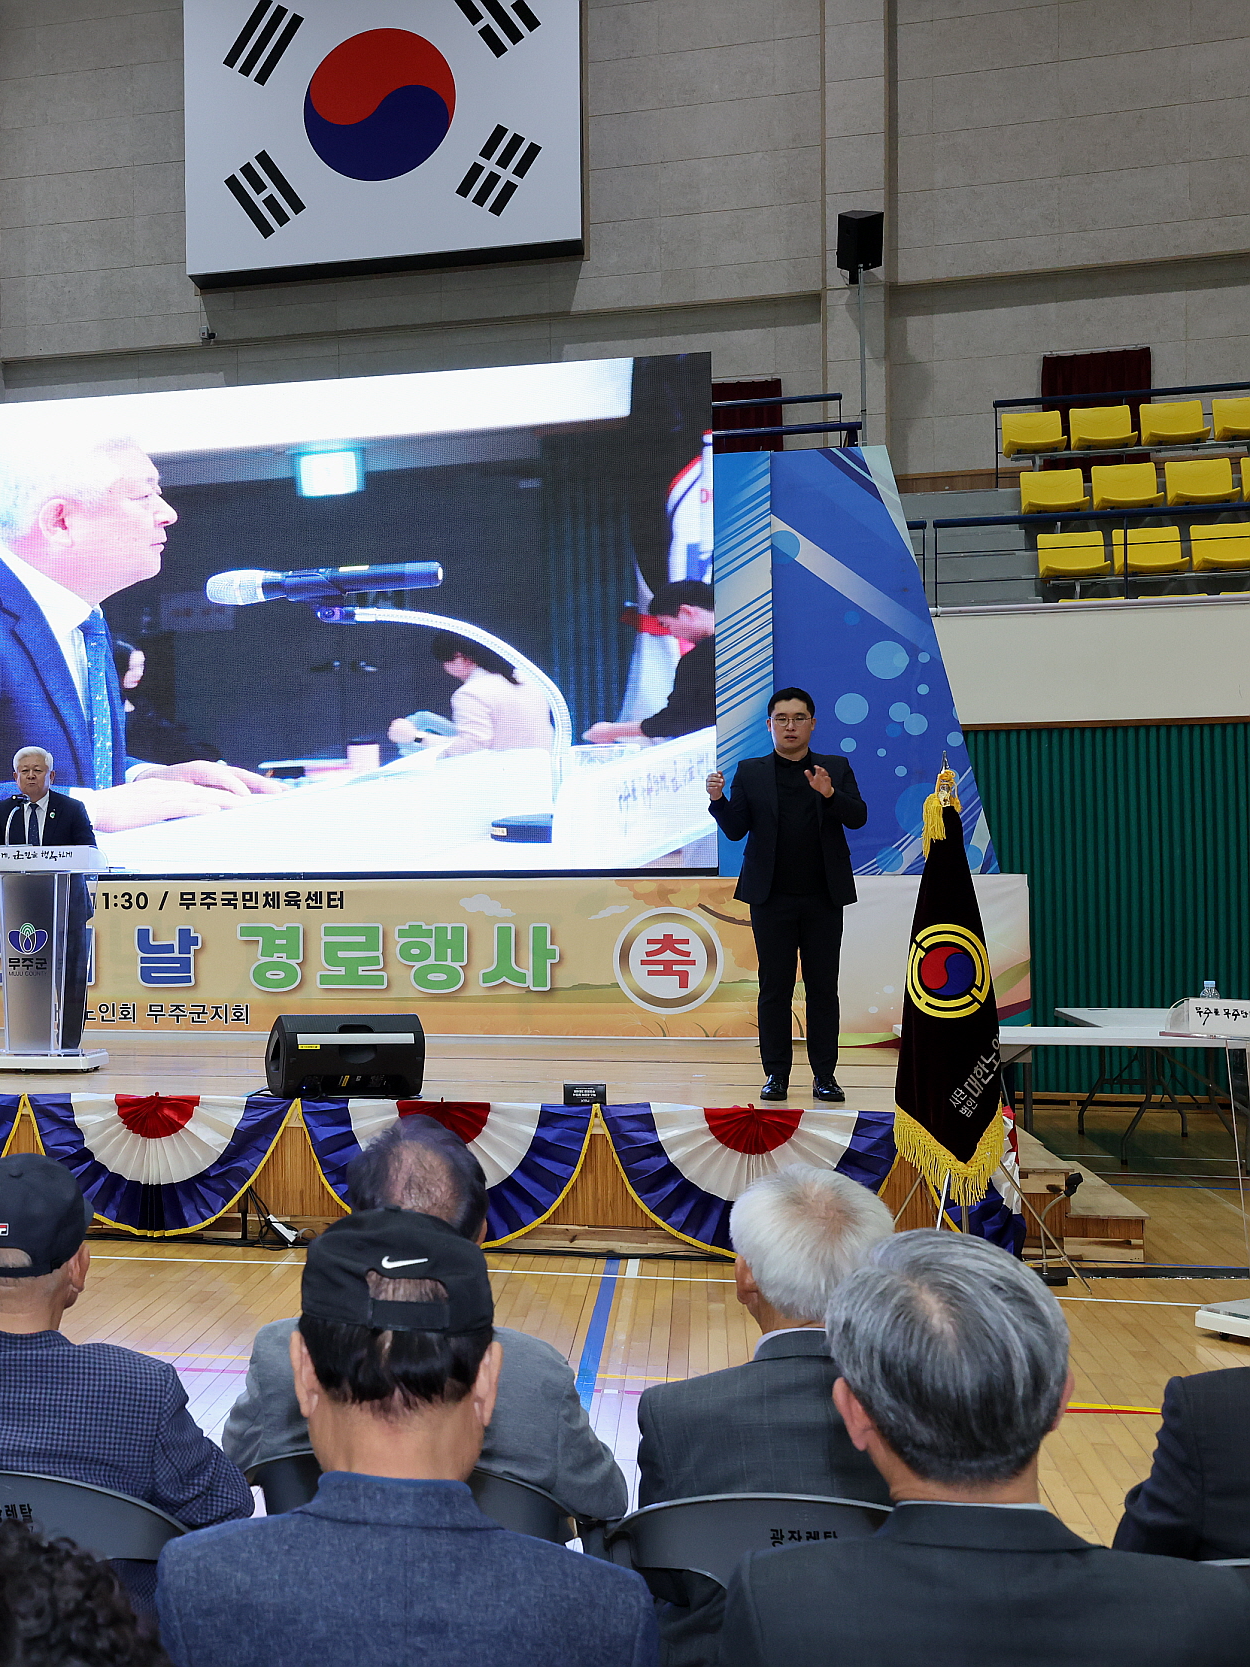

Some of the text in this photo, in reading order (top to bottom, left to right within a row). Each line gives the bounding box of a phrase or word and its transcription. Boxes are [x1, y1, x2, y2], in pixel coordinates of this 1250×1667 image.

[158, 890, 169, 911] /
[178, 889, 345, 911] 무주국민체육센터
[8, 957, 48, 970] 무주군
[134, 925, 203, 988] 날
[237, 922, 559, 993] 경로행사
[640, 933, 696, 989] 축
[146, 1003, 250, 1024] 무주군지회
[1222, 1008, 1250, 1022] 무주답
[949, 1088, 968, 1108] 사단
[958, 1097, 978, 1118] 법인
